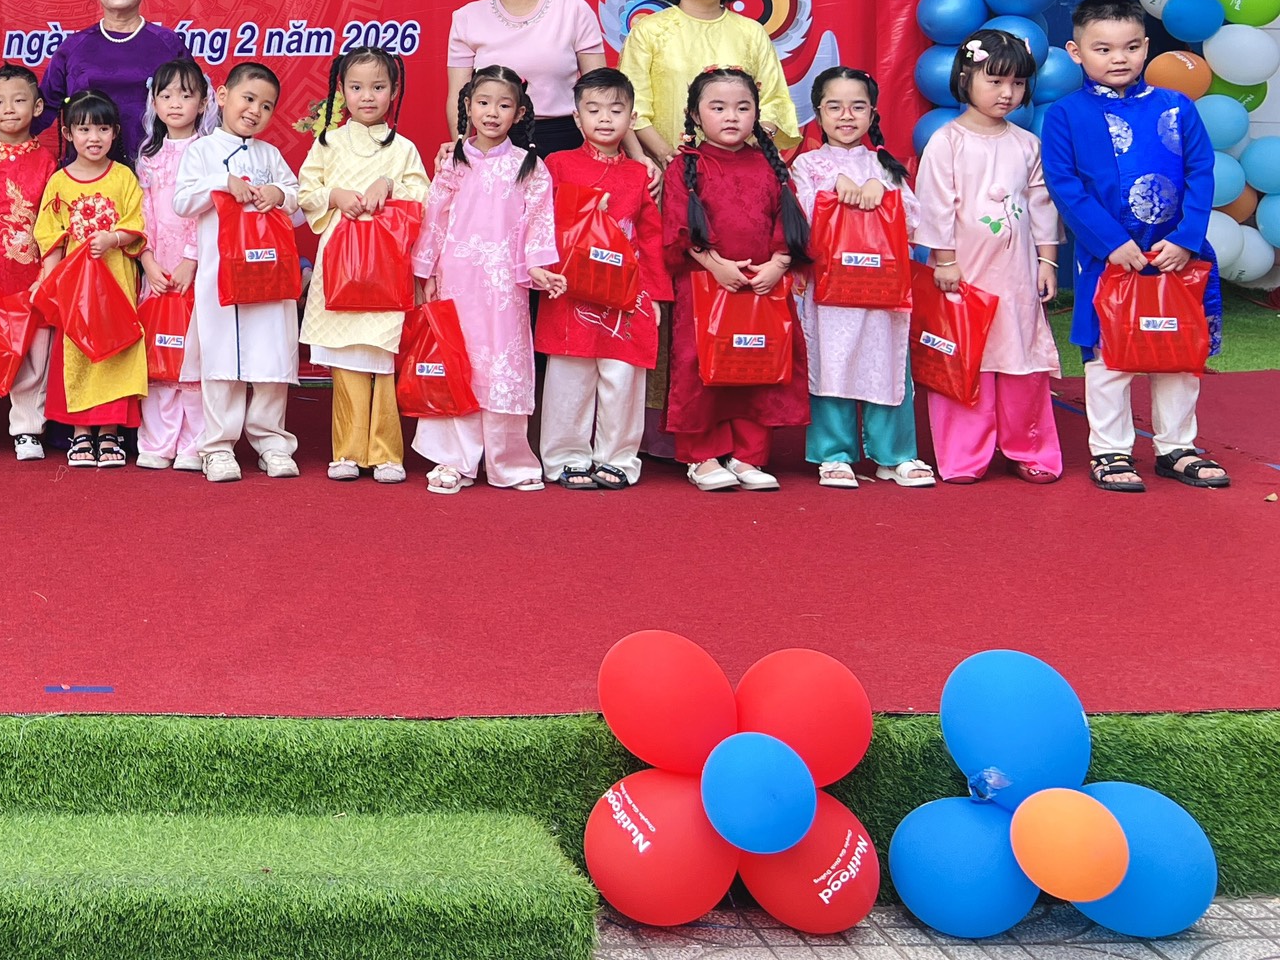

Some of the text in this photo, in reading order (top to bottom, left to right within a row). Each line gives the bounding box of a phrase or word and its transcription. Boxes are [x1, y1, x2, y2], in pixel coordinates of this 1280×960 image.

[235, 23, 257, 55] 2
[266, 20, 333, 55] năm
[342, 21, 419, 55] 2026
[255, 249, 276, 261] VAS
[599, 251, 622, 264] VAS
[855, 255, 880, 267] VAS
[1153, 318, 1178, 330] VAS
[164, 336, 183, 347] VAS
[742, 336, 765, 347] VAS
[932, 338, 955, 354] VAS
[425, 364, 445, 375] VAS
[602, 788, 651, 853] Nutifood
[818, 834, 869, 905] Nutifood
